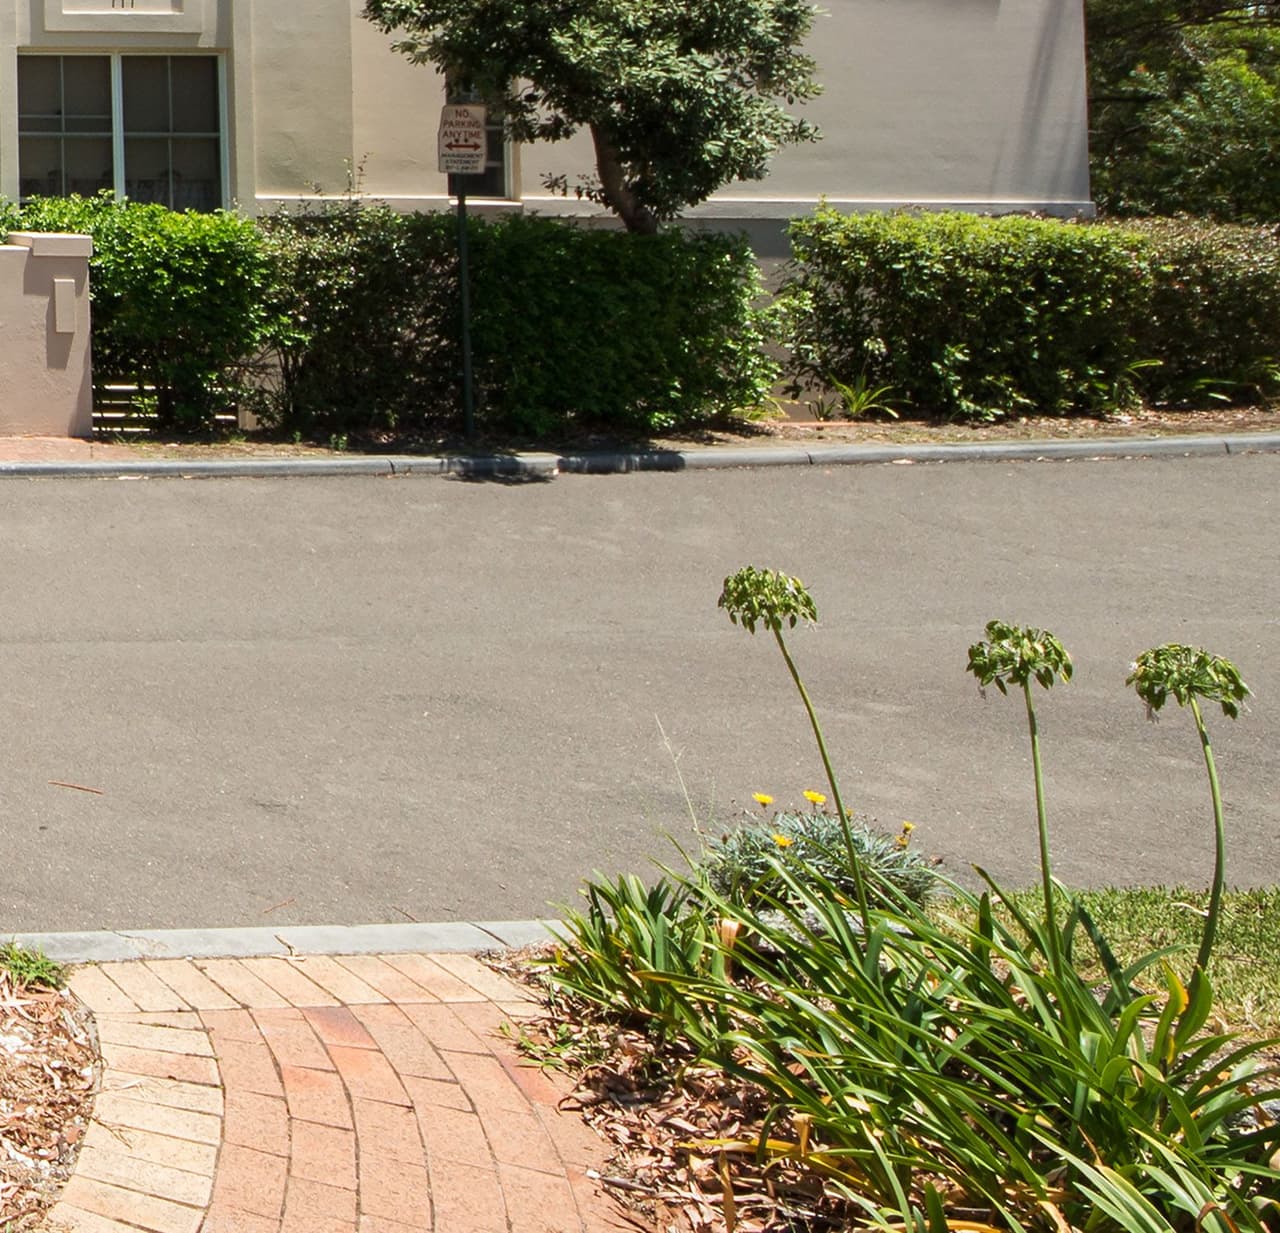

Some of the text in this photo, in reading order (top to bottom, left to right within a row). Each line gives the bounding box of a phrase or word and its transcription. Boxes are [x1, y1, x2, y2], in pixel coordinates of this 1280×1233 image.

[455, 109, 469, 118] NO
[442, 120, 480, 128] PARKING
[442, 130, 482, 139] ANYTIME
